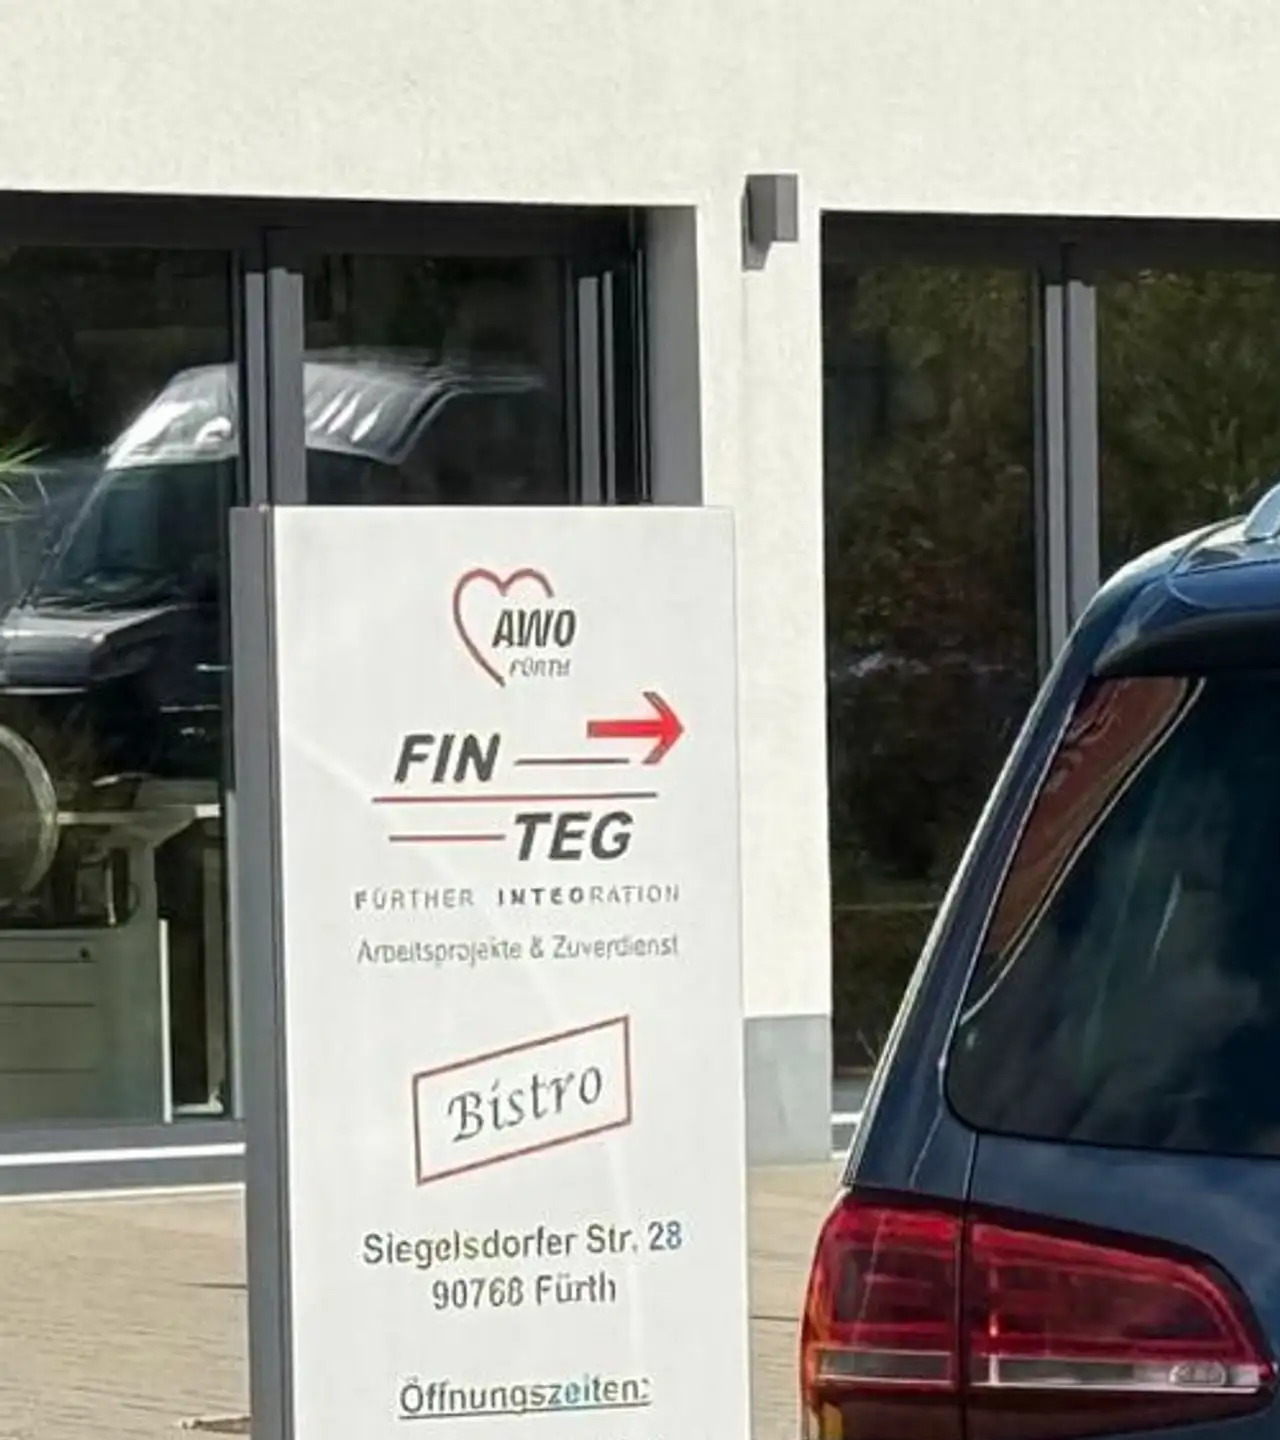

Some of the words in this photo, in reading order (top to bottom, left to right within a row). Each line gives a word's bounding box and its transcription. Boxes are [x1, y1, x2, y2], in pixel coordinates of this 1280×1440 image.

[492, 608, 576, 649] AWO
[394, 733, 501, 784] FIN
[513, 811, 634, 861] TEG
[353, 885, 475, 911] FÜRTHER
[356, 937, 522, 969] Arbeitsprojekte
[529, 936, 546, 960] &
[551, 934, 679, 962] Zuverdienst
[447, 1066, 603, 1143] Bistro
[363, 1226, 577, 1270] Siegelsdorfer
[586, 1223, 638, 1255] Str.
[648, 1220, 683, 1252] 28
[431, 1276, 525, 1310] 90768
[534, 1270, 617, 1306] Fürth
[398, 1372, 651, 1416] Öffnungszeiten:
